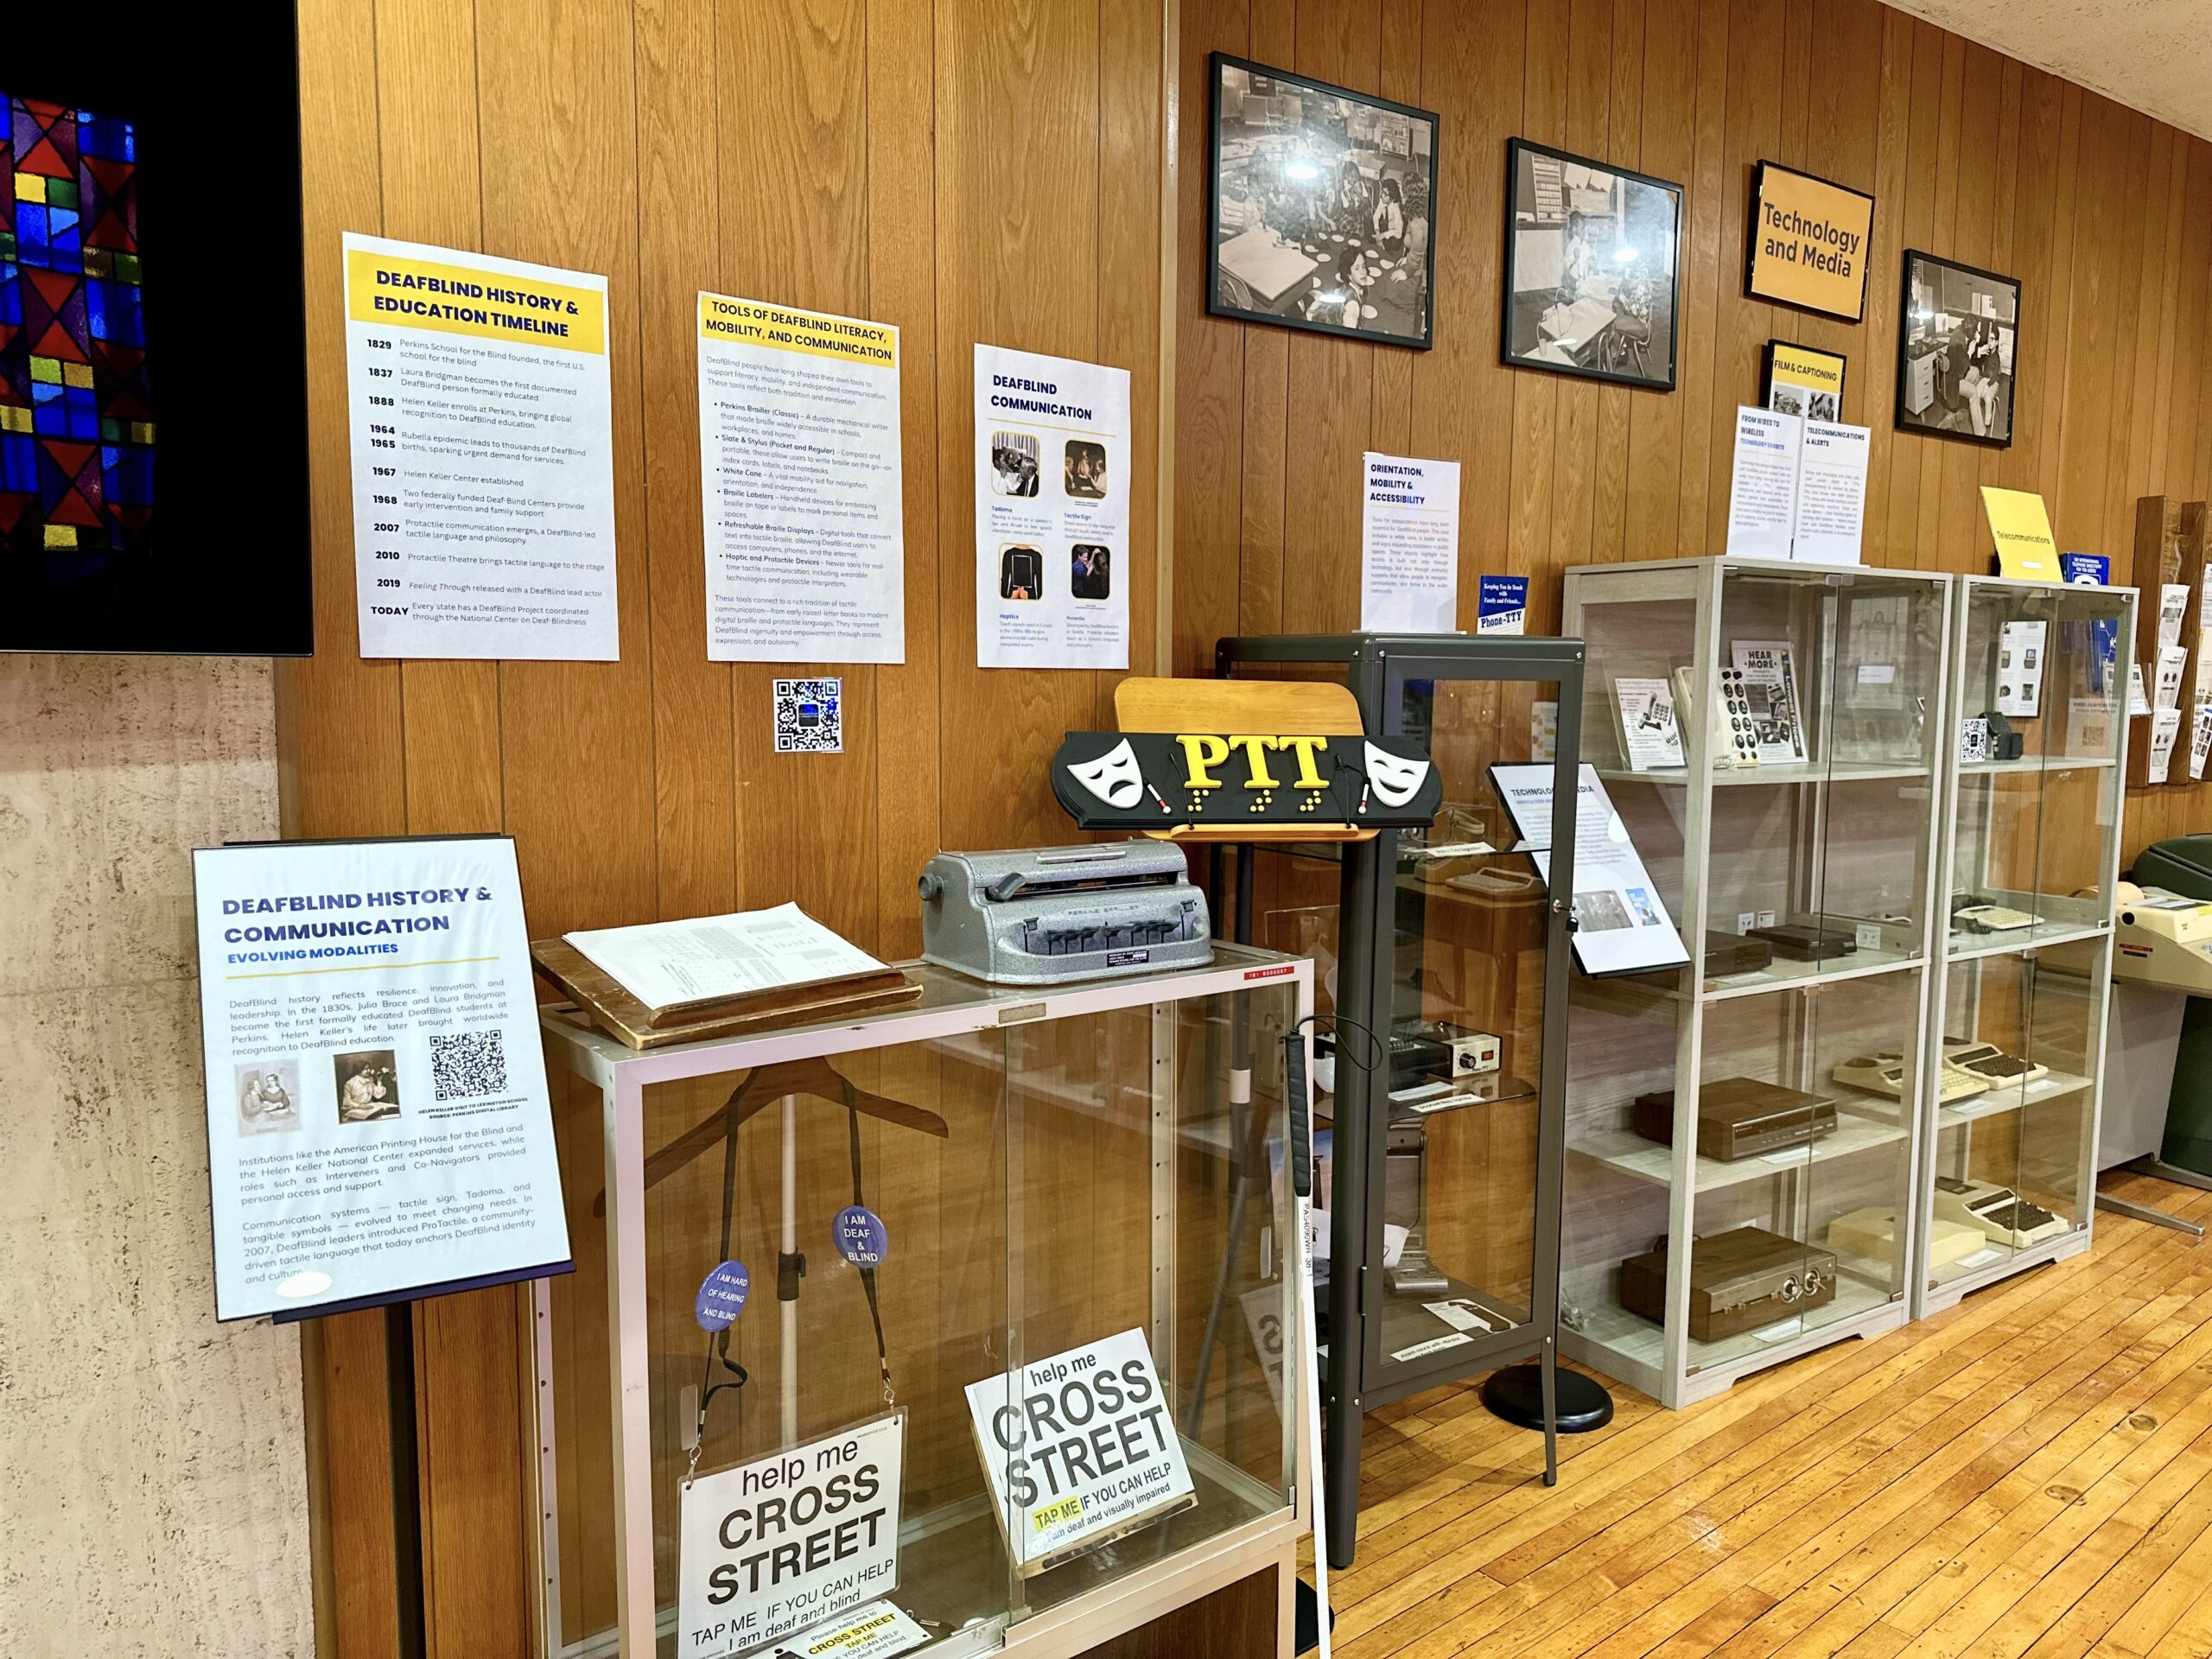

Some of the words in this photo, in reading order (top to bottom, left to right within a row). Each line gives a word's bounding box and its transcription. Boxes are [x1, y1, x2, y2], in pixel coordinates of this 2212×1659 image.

[1764, 201, 1859, 254] Technology
[1764, 238, 1797, 263] and
[1802, 244, 1853, 278] Media
[376, 270, 483, 298] DEAFBLIND
[486, 287, 562, 312] HISTORY
[565, 301, 579, 315] &
[373, 296, 487, 324] EDUCATION
[490, 312, 569, 337] TIMELINE
[711, 301, 750, 317] TOOLS
[753, 308, 768, 320] OF
[771, 311, 831, 332] DEAFBLIND
[834, 323, 887, 343] LITERACY,
[366, 339, 391, 349] 1829
[706, 318, 765, 340] MOBILITY,
[767, 329, 791, 343] AND
[794, 334, 891, 360] COMMUNICATION
[368, 367, 392, 378] 1837
[1774, 359, 1790, 371] FILM
[1790, 363, 1796, 372] &
[1796, 365, 1837, 381] CAPTIONING
[993, 374, 1057, 394] DEAFBLIND
[368, 396, 394, 406] 1888
[990, 395, 1091, 420] COMMUNICATION
[1741, 414, 1756, 423] FROM
[1757, 417, 1772, 426] WIRES
[370, 424, 395, 434] 1964
[1740, 427, 1764, 437] WIRELESS
[1807, 427, 1865, 441] TELECOMMUNICATIONS
[371, 438, 395, 448] 1965
[1810, 438, 1828, 447] ALERTS
[372, 467, 396, 476] 1967
[1370, 463, 1423, 477] ORIENTATION,
[1370, 478, 1406, 489] MOBILITY
[372, 494, 397, 505] 1968
[1370, 493, 1425, 505] ACCESSIBILITY
[373, 523, 399, 532] 2007
[1996, 531, 2050, 544] Telecommunications
[375, 550, 399, 560] 2010
[377, 578, 400, 588] 2019
[370, 606, 409, 615] TODAY
[1480, 610, 1522, 628] Phone-TTY
[1748, 651, 1771, 659] HEAR
[1747, 660, 1774, 669] MORE
[1176, 734, 1330, 789] PTT
[1510, 785, 1554, 796] TECHNOLO
[222, 893, 362, 914] DEAFBLIND
[366, 887, 469, 907] HISTORY
[475, 887, 493, 900] &
[224, 915, 449, 943] COMMUNICATION
[228, 949, 307, 963] EVOLVING
[309, 944, 398, 958] MODALITIES
[229, 997, 276, 1008] DeafBlind
[289, 995, 321, 1004] history
[332, 991, 365, 1000] reflects
[376, 988, 419, 996] resilience,
[429, 982, 477, 991] innovation,
[487, 978, 504, 987] and
[230, 1009, 282, 1020] leadership.
[301, 1006, 316, 1014] the
[322, 1003, 353, 1013] 1830s,
[357, 1001, 377, 1011] Julia
[411, 995, 429, 1005] and
[463, 991, 505, 1001] Bridgman
[850, 1215, 866, 1224] AM
[843, 1228, 869, 1237] DEAF
[857, 1241, 865, 1250] &
[847, 1251, 878, 1262] BLIND
[720, 1274, 731, 1283] AM
[730, 1275, 747, 1287] HARD
[708, 1288, 717, 1297] OF
[717, 1290, 745, 1303] HEARING
[702, 1307, 717, 1317] AND
[717, 1310, 736, 1320] BLIND
[1030, 1363, 1068, 1386] help
[1071, 1354, 1096, 1372] me
[993, 1359, 1153, 1452] CROSS
[1005, 1405, 1166, 1509] STREET
[742, 1458, 805, 1496] help
[817, 1440, 858, 1472] me
[1035, 1510, 1058, 1529] TAP
[1061, 1500, 1080, 1518] ME
[1080, 1495, 1090, 1510] IF
[1092, 1487, 1117, 1506] YOU
[1119, 1476, 1142, 1494] CAN
[1145, 1462, 1172, 1484] HELP
[719, 1464, 880, 1549] CROSS
[1067, 1518, 1085, 1535] deaf
[1087, 1510, 1103, 1527] and
[1103, 1495, 1135, 1517] visually
[1135, 1483, 1170, 1507] impaired
[707, 1507, 887, 1605] STREET
[692, 1623, 725, 1646] TAP
[730, 1611, 757, 1634] ME
[767, 1603, 781, 1619] IF
[785, 1589, 818, 1612] YOU
[823, 1574, 853, 1599] CAN
[857, 1559, 893, 1585] HELP
[738, 1630, 761, 1648] am
[765, 1616, 798, 1639] deaf
[800, 1605, 825, 1624] and
[830, 1590, 861, 1612] blind
[809, 1630, 853, 1655] CROSS
[852, 1613, 897, 1636] STREET
[811, 1626, 837, 1642] Please
[838, 1619, 855, 1630] help
[845, 1639, 863, 1649] TAP
[864, 1632, 878, 1641] ME
[861, 1640, 879, 1649] CAN
[880, 1630, 899, 1642] HELP
[874, 1643, 888, 1654] and
[888, 1636, 906, 1645] blind
